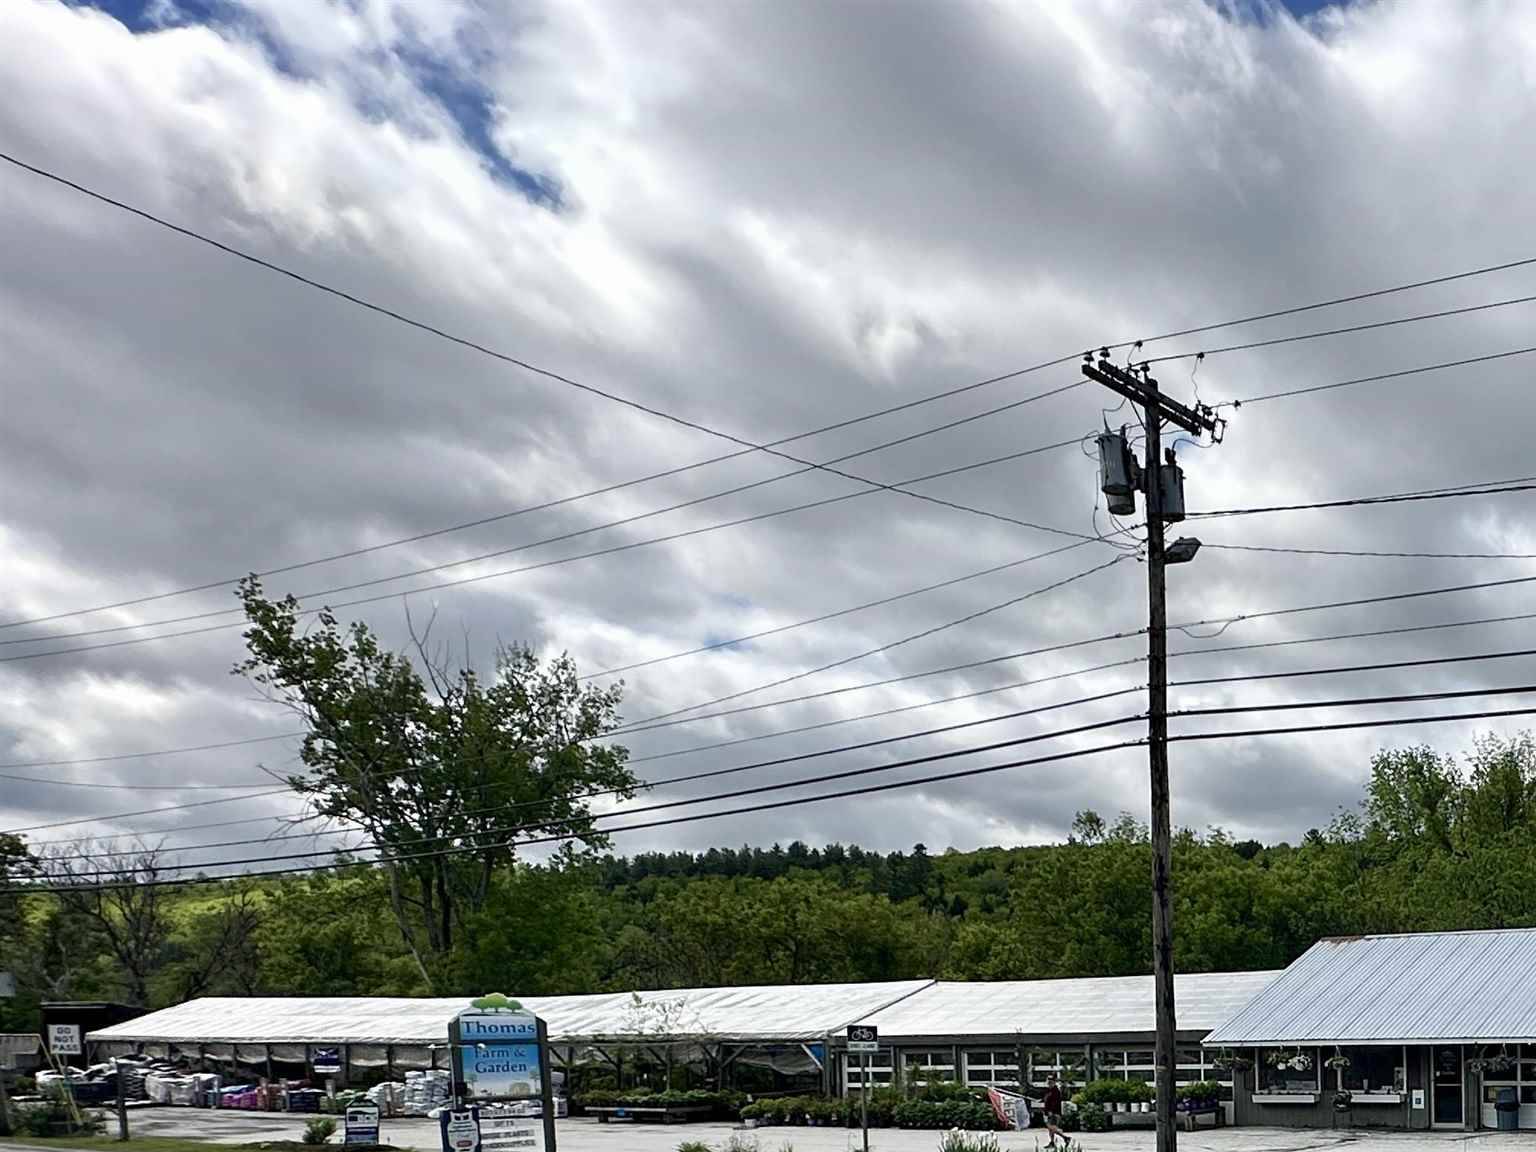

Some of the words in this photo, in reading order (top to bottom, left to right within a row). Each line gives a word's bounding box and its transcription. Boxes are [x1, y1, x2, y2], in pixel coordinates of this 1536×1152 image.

[462, 1020, 537, 1034] Thomas
[54, 1035, 74, 1043] NOT
[513, 1047, 527, 1058] &
[474, 1060, 528, 1074] Garden
